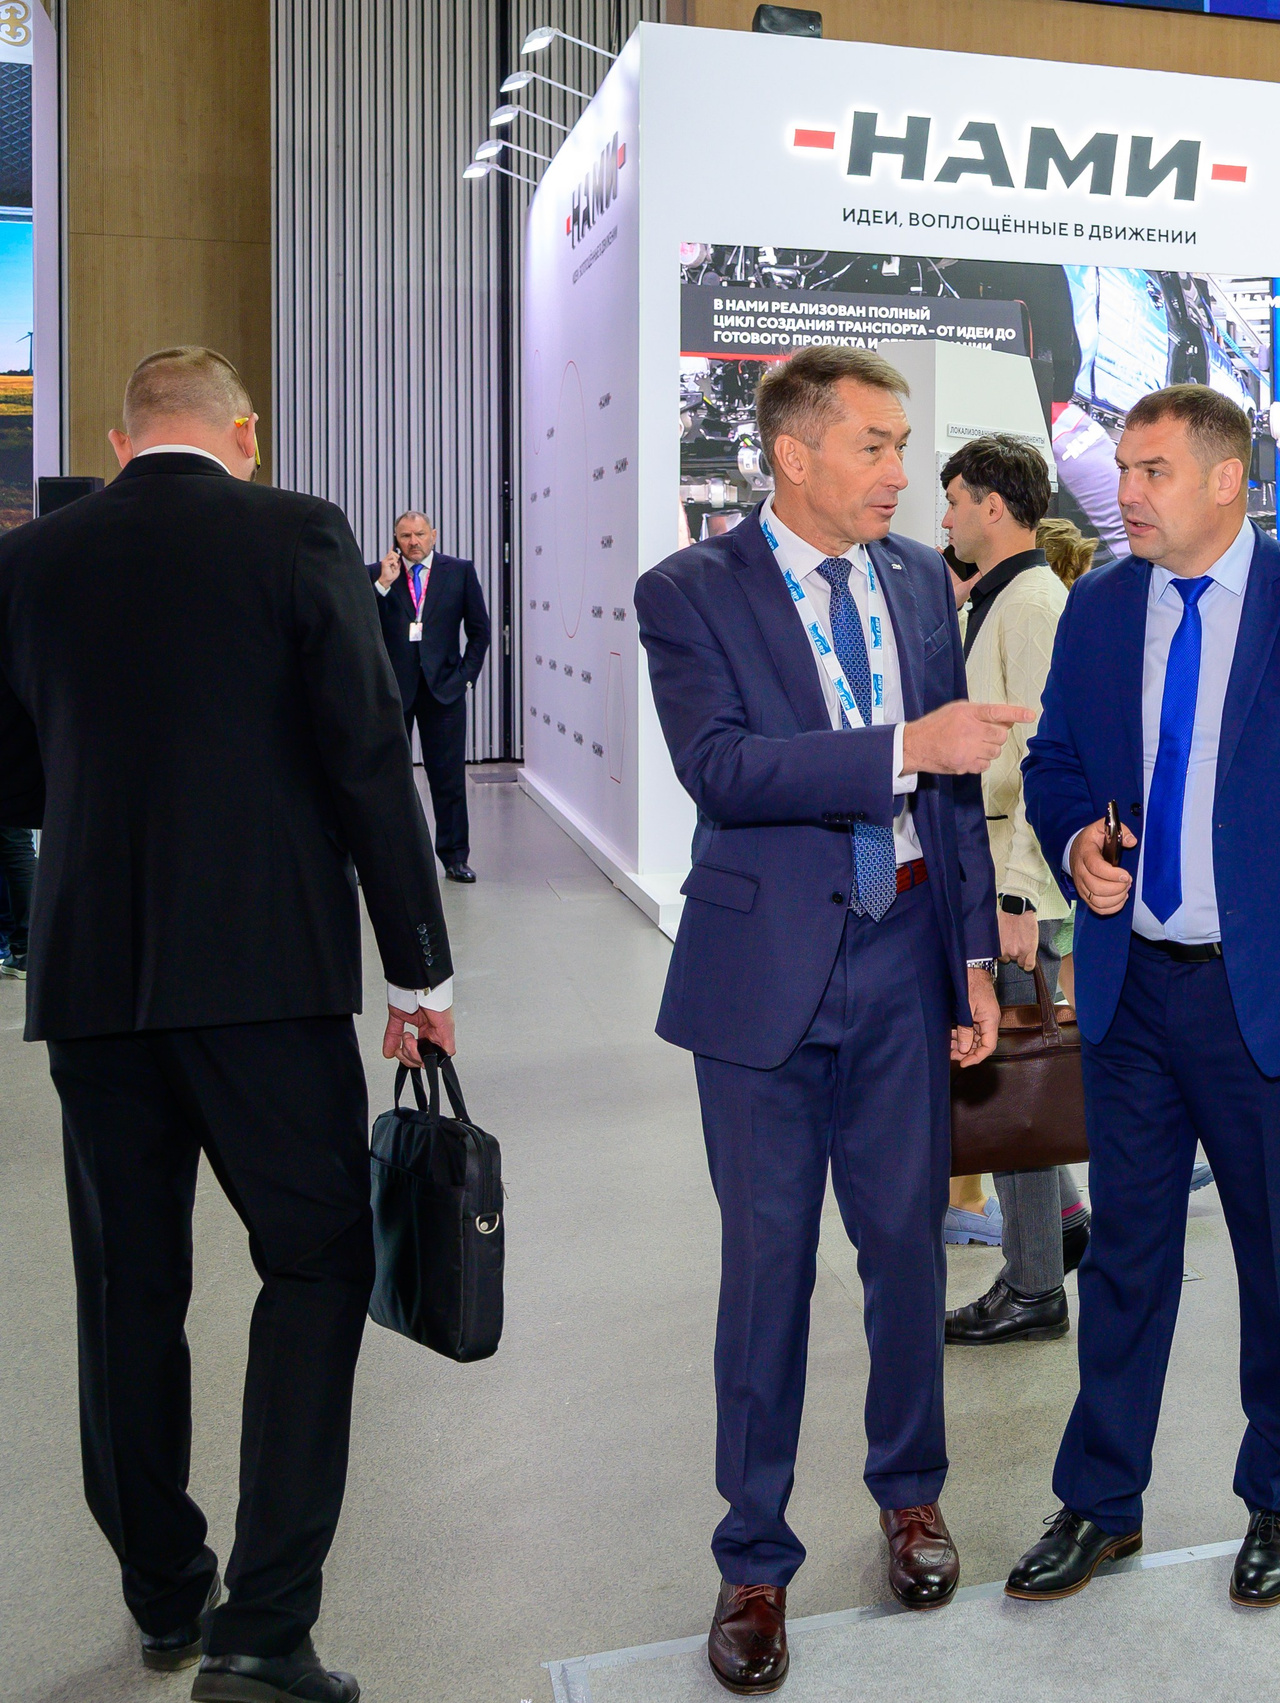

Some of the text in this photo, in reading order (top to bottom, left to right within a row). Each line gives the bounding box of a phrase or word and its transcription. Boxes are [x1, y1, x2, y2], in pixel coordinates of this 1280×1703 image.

[847, 111, 1201, 201] НАМИ
[843, 207, 1197, 245] ИДЕИ, ВОПЛОЩЁННЫЕ В ДВИЖЕНИИ
[713, 299, 930, 320] В НАМИ РЕАЛИЗОВАН ПОЛНЫЙ
[713, 315, 754, 329] ЦИКЛ
[756, 317, 835, 331] СОЗДАНИЯ
[837, 321, 927, 336] ТРАНСПОРТА
[936, 325, 955, 338] ОТ
[956, 326, 994, 340] ИДЕИ
[995, 328, 1016, 341] ДО
[713, 331, 790, 345] ГОТОВОГО
[868, 338, 878, 350] И
